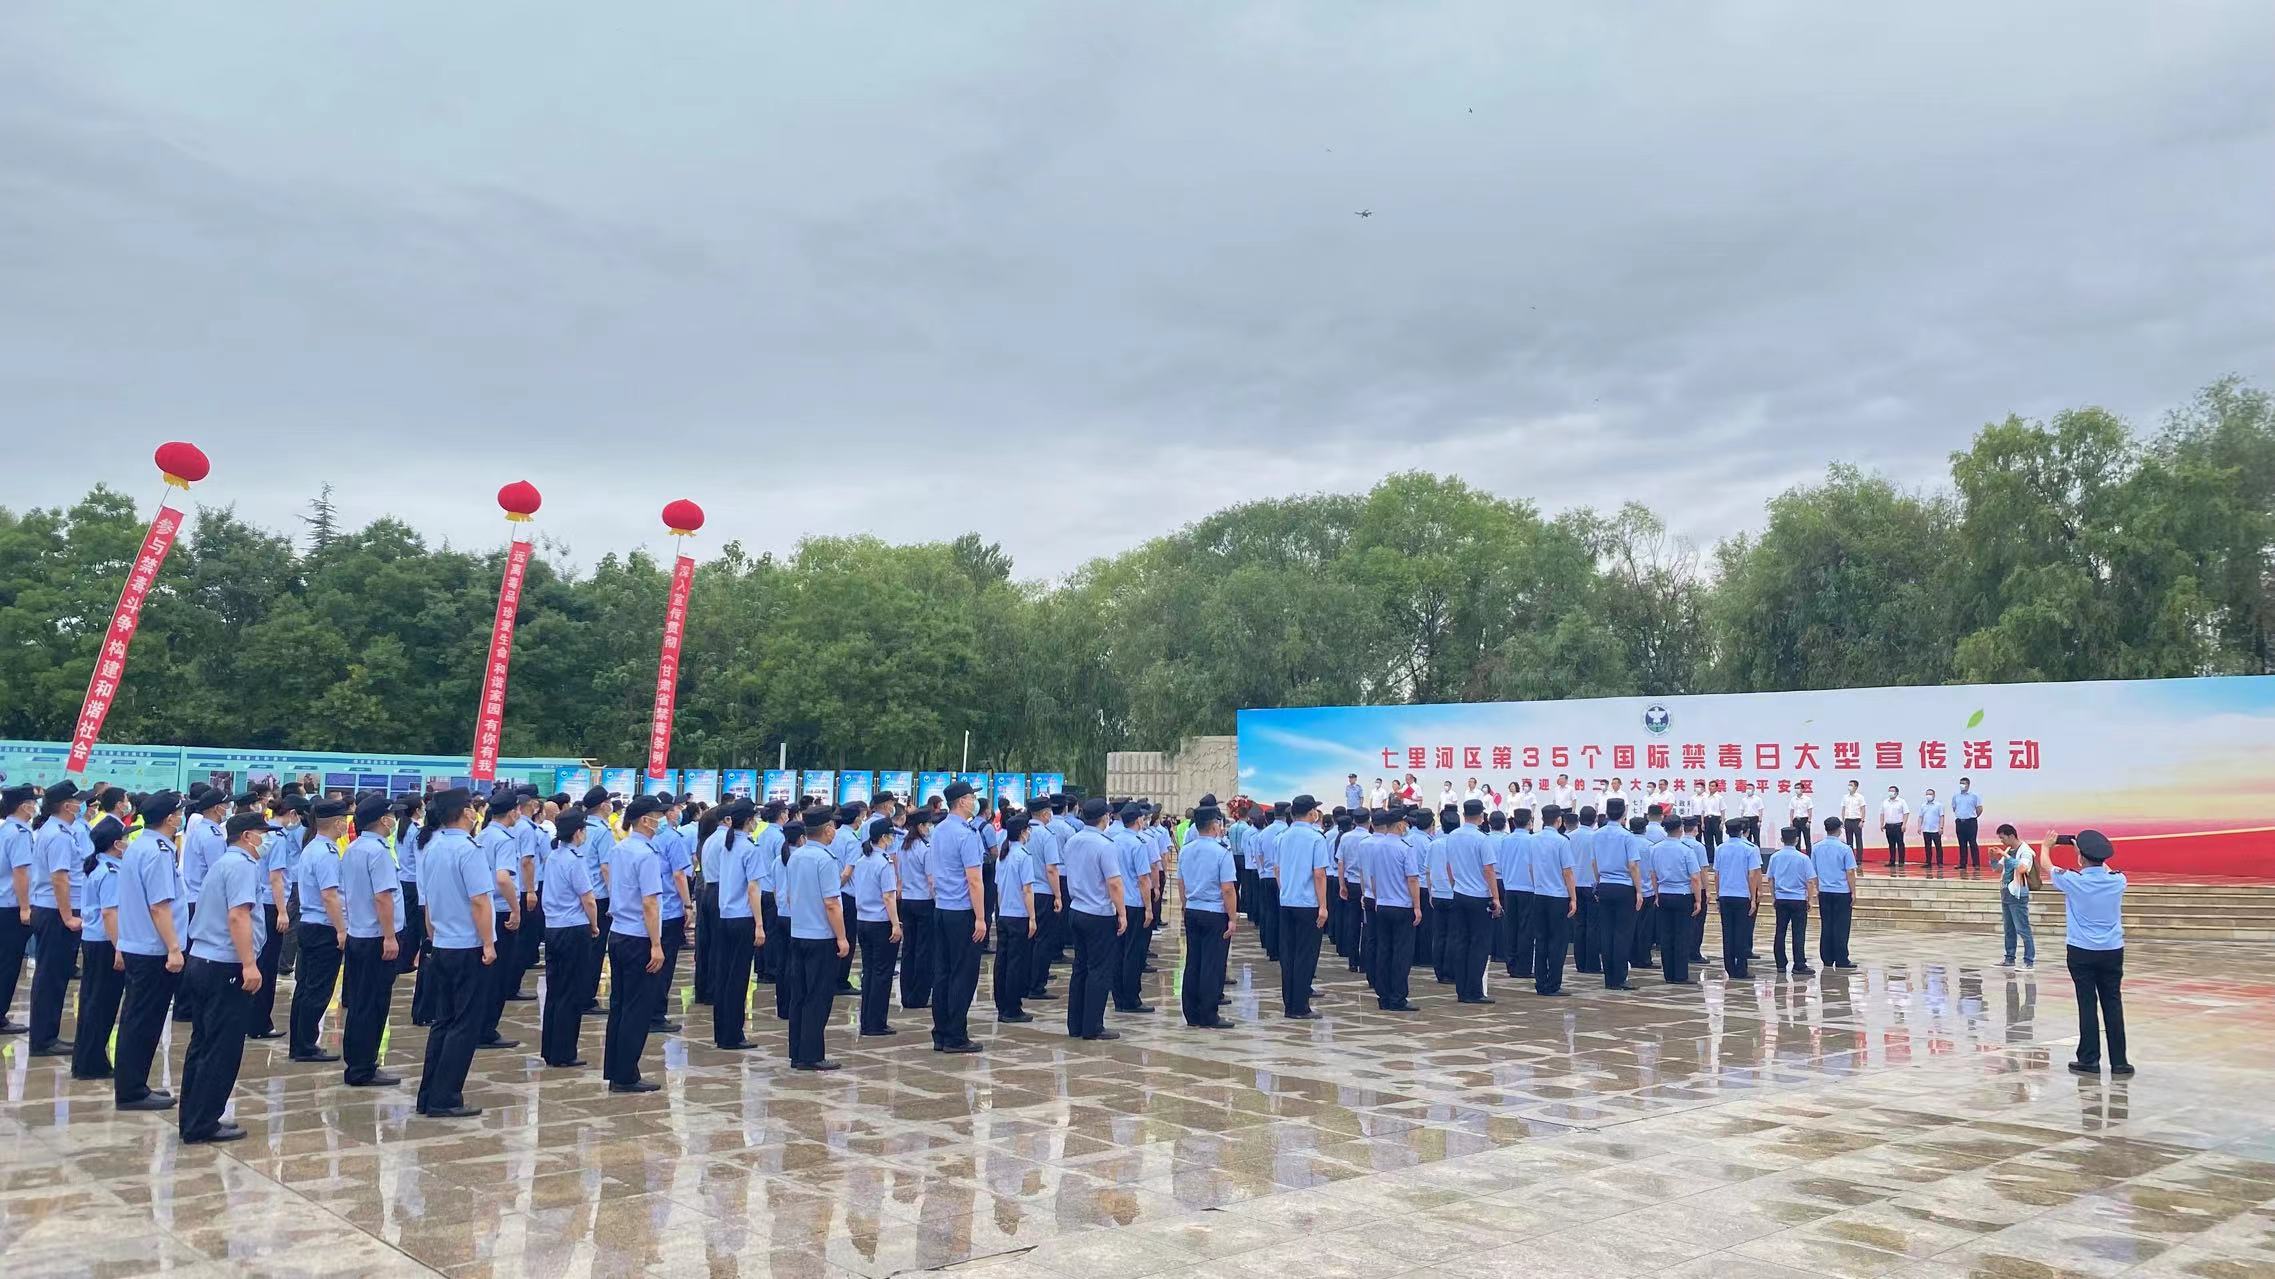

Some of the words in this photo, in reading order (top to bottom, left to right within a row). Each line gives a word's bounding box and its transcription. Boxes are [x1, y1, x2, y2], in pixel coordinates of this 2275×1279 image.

[116, 517, 175, 633] 参与禁毒斗争
[72, 638, 125, 760] 构建和谐社会
[477, 718, 499, 772] 有你有我
[1381, 739, 2040, 770] 七里河区第35个国际禁毒日大型宣传活动
